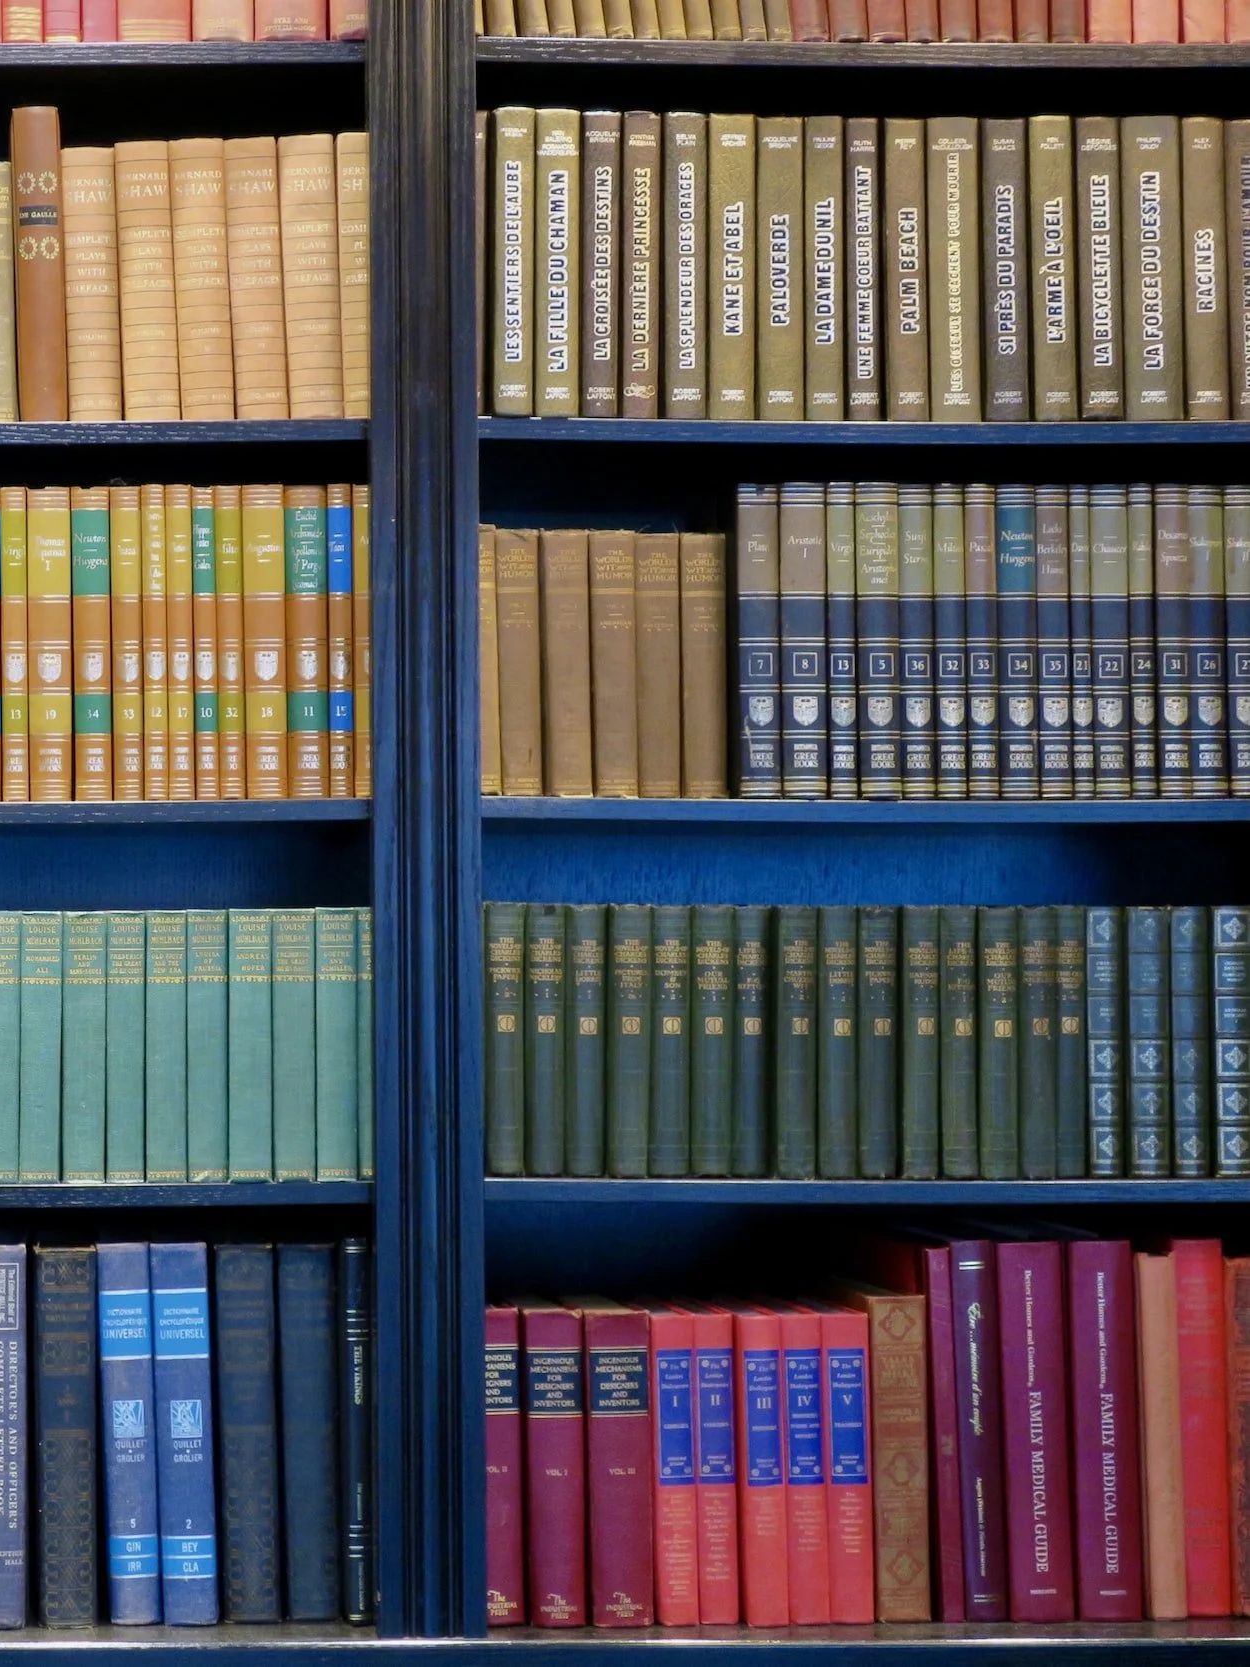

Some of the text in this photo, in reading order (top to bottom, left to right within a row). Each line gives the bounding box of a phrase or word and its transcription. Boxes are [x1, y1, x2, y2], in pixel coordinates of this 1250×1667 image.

[506, 162, 521, 360] LES SENTIERS DE L'AUBE
[592, 167, 611, 359] LA CROISÉE DES DESTINS
[679, 163, 694, 368] LA SPLENDEUR DES ORAGES
[549, 172, 567, 370] LA FILLE DU CHAMAN
[631, 169, 650, 370] LA DERNIÈRE PRINCESSE
[725, 203, 742, 334] KANE ET ABEL
[771, 216, 788, 325] PALOVERDE
[816, 198, 833, 344] LA DAME DU NIL
[856, 168, 873, 377] UNE FEMME COEUR BATTANT
[899, 209, 918, 332] PALM BEACH
[948, 152, 963, 390] LES OISEAUX SE CACHENT POUR MOURIR
[995, 185, 1015, 353] SI PRÈS DU PARADIS
[1041, 198, 1064, 342] L'ARME À L'OEIL
[1091, 177, 1111, 365] LA BICYCLETTE BLEUE
[1141, 173, 1163, 369] LA FORCE DU DESTIN
[1196, 228, 1215, 311] RACINES
[838, 660, 850, 670] 13
[878, 660, 886, 670] 5
[912, 660, 924, 670] 36
[946, 660, 958, 670] 32
[978, 660, 990, 670] 33
[1014, 660, 1028, 670] 34
[1050, 660, 1062, 670] 35
[1104, 660, 1118, 672] 22
[1170, 658, 1180, 670] 31
[200, 708, 212, 718] 10
[262, 706, 272, 718] 18
[304, 706, 314, 716] 11
[160, 1328, 204, 1340] UNIVERSEL
[535, 1382, 574, 1391] DESIGNERS
[546, 1391, 562, 1399] AND
[798, 1395, 811, 1407] IV
[843, 1394, 852, 1405] V
[534, 1400, 575, 1408] INVENTORS
[757, 1397, 772, 1409] III
[8, 1341, 18, 1529] DIRECTOR'S AND OFFICER'S
[1029, 1391, 1049, 1572] FAMILY MEDICAL GUIDE
[1100, 1393, 1119, 1574] FAMILY MEDICAL GUIDE
[130, 1518, 136, 1528] 5
[186, 1518, 192, 1530] 2
[126, 1542, 142, 1552] GIN
[182, 1542, 198, 1552] BEY
[128, 1560, 142, 1572] IRR
[182, 1562, 198, 1572] CLA
